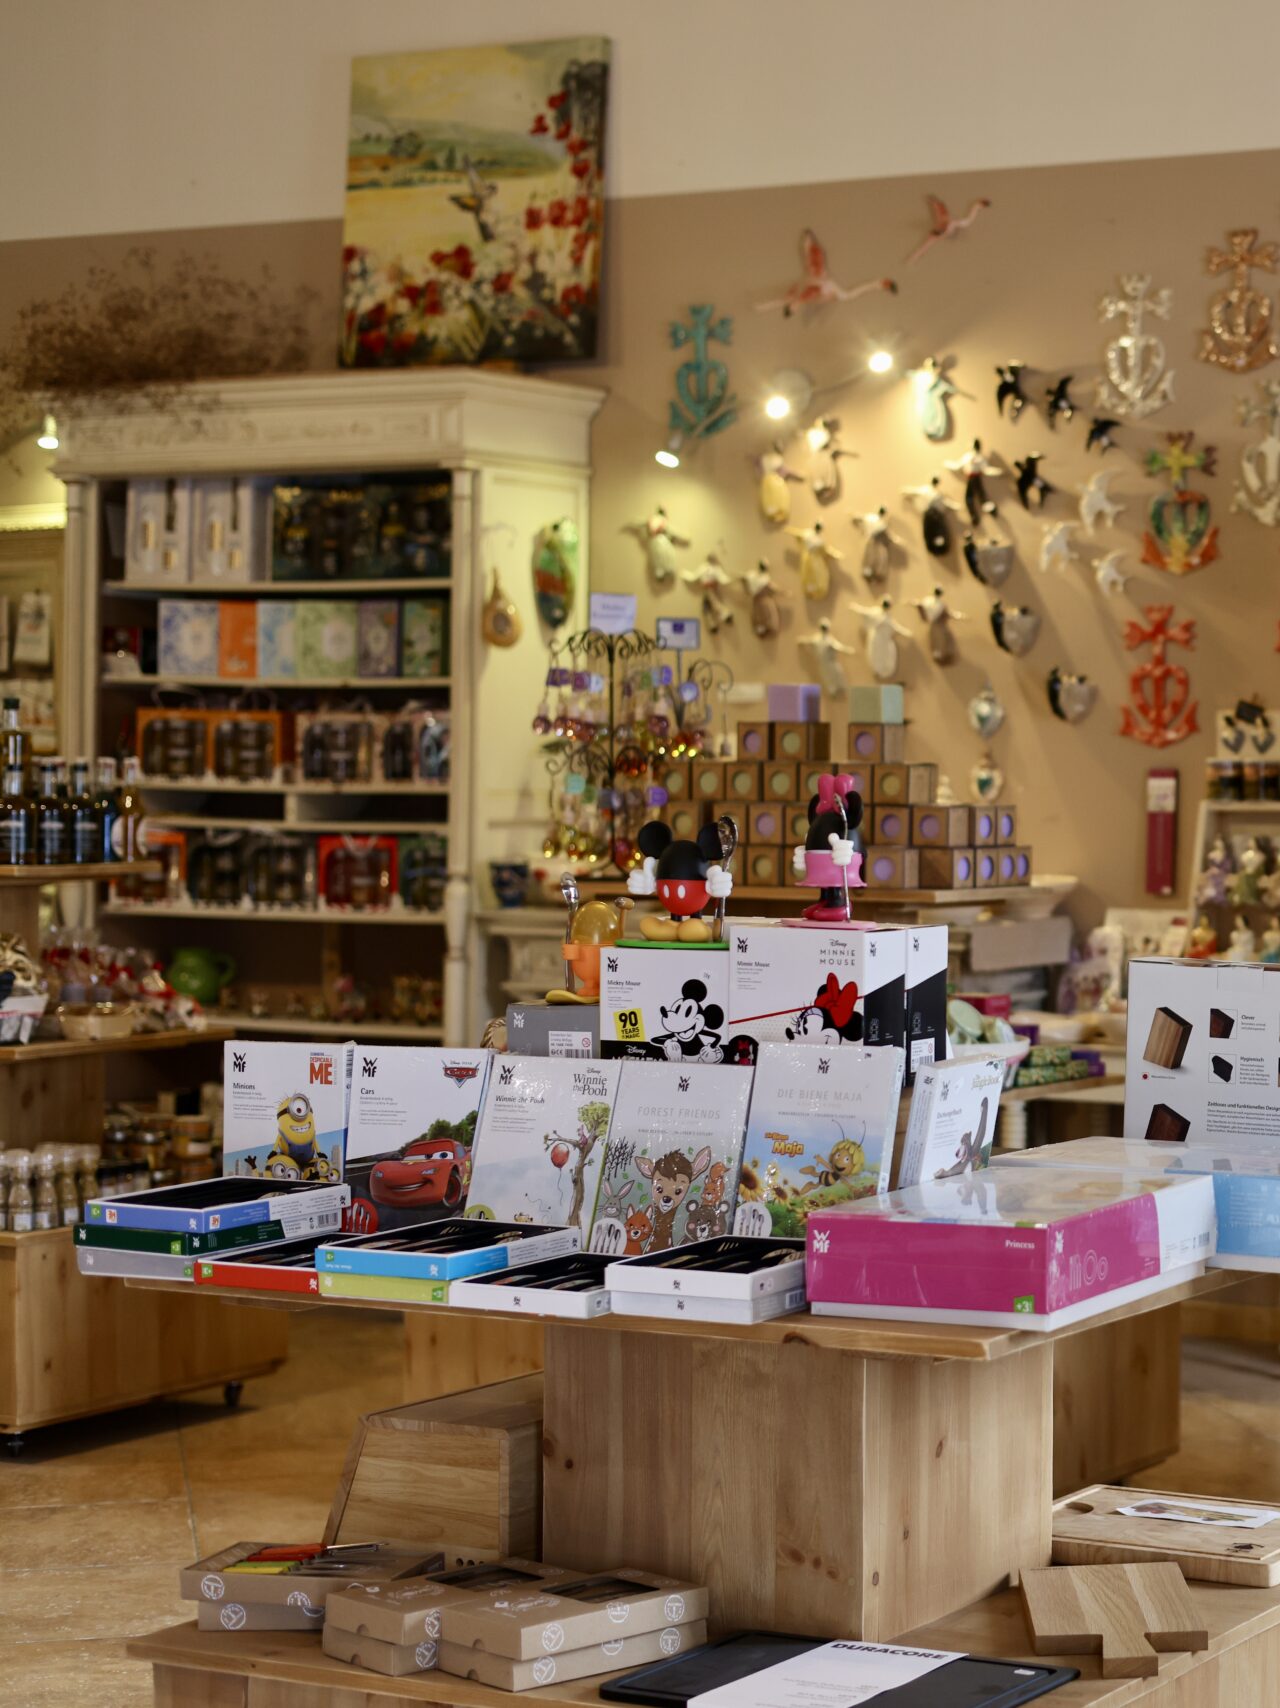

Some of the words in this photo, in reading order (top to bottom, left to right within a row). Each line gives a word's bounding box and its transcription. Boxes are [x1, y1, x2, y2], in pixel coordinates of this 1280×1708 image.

[820, 949, 856, 957] MINNIE
[618, 1011, 639, 1028] 90
[625, 1045, 646, 1055] Disney
[310, 1063, 333, 1085] ME
[573, 1074, 608, 1085] Winnie
[233, 1082, 256, 1090] Minions
[572, 1084, 584, 1092] the
[582, 1084, 608, 1096] Pooh
[496, 1095, 517, 1103] Winnie
[777, 1088, 794, 1099] DIE
[799, 1089, 829, 1100] BIENE
[833, 1091, 862, 1102] MAJA
[638, 1106, 674, 1117] FOREST
[679, 1108, 720, 1120] FRIENDS
[772, 1141, 804, 1157] Maja
[1005, 1239, 1036, 1250] Princess
[831, 1643, 948, 1659] DURACORE
